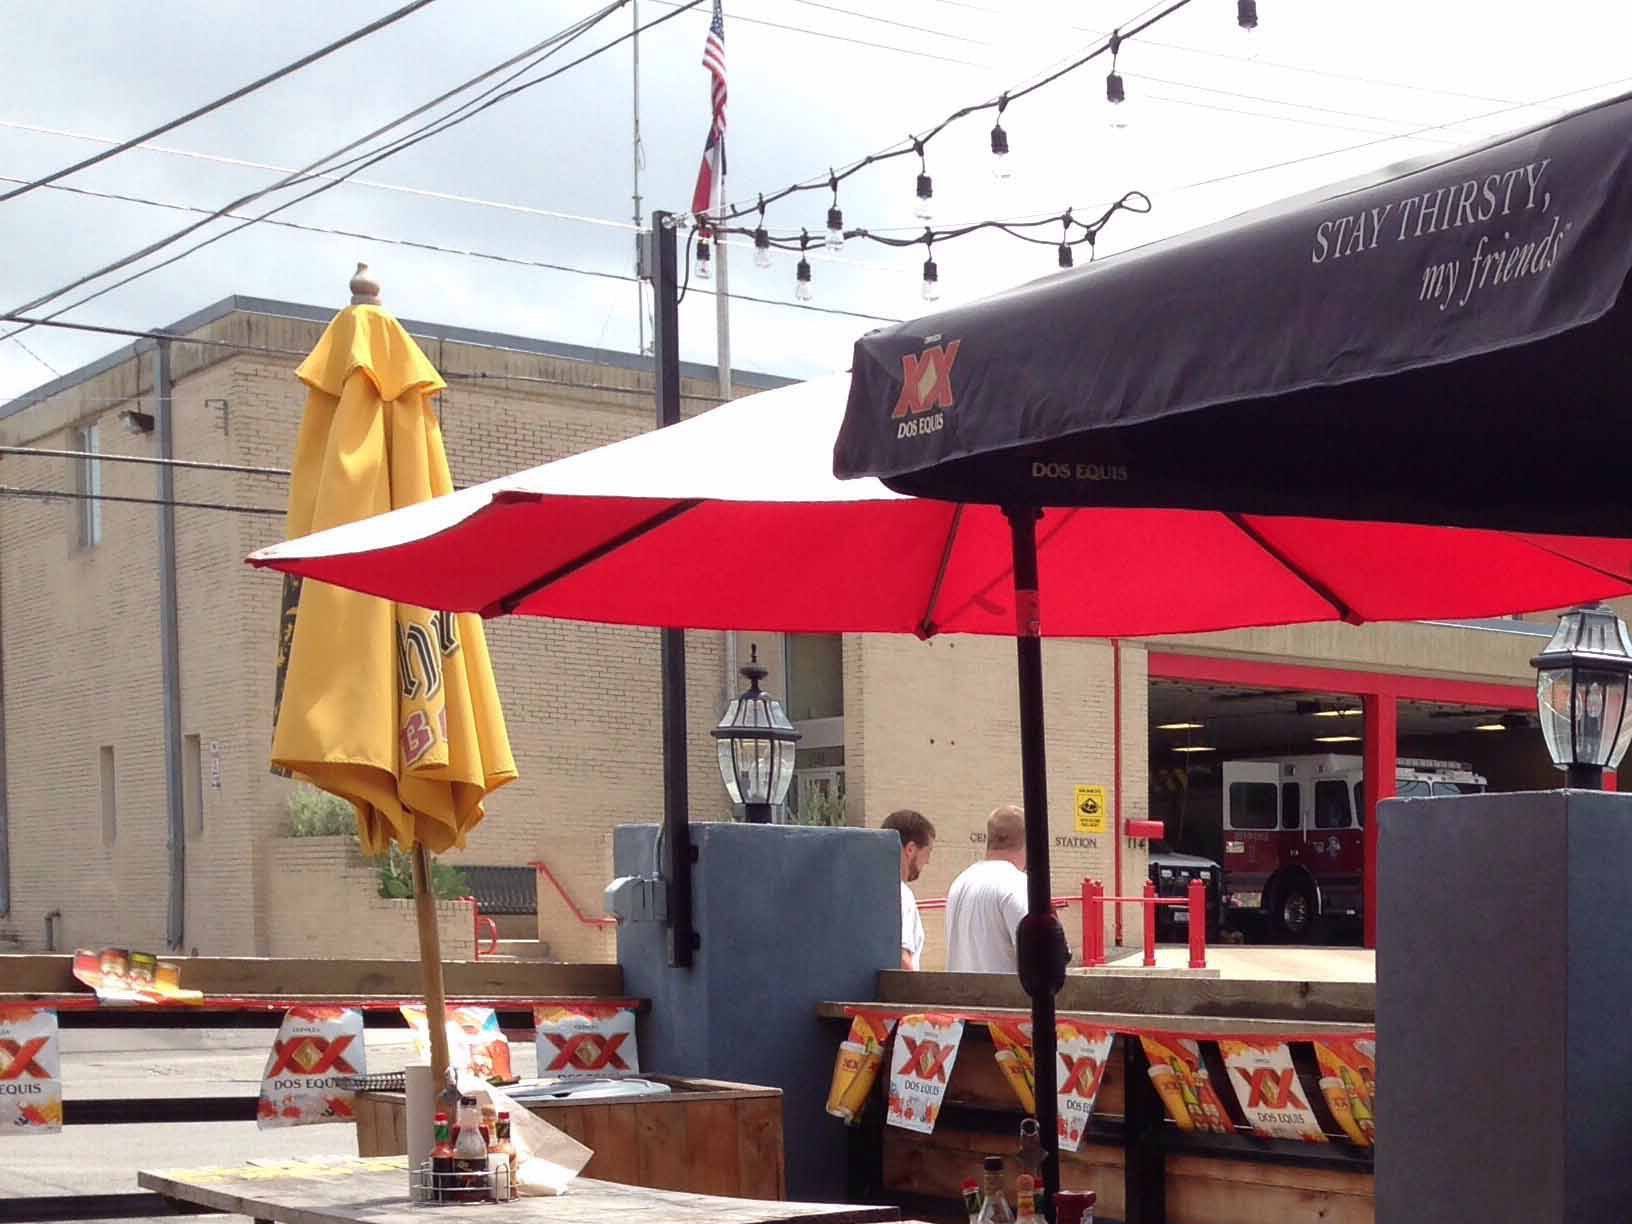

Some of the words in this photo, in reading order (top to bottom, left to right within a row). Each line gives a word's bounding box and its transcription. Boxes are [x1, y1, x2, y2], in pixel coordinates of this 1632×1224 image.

[1312, 204, 1392, 263] STAY
[1398, 158, 1552, 241] THIRSTY,
[1419, 260, 1461, 311] my
[1459, 215, 1565, 306] friends
[892, 339, 961, 418] XX
[897, 417, 919, 439] DOS
[919, 412, 945, 435] EQUIS
[1032, 461, 1071, 479] DOS
[1075, 463, 1129, 481] EQUIS
[1056, 836, 1097, 849] STATION
[267, 1034, 358, 1079] XX
[542, 1032, 631, 1072] XX
[897, 1034, 955, 1084] XX
[274, 1079, 301, 1091] DOS
[905, 1080, 920, 1092] DOS
[1233, 1066, 1309, 1111] XX
[1257, 1112, 1277, 1123] DOS
